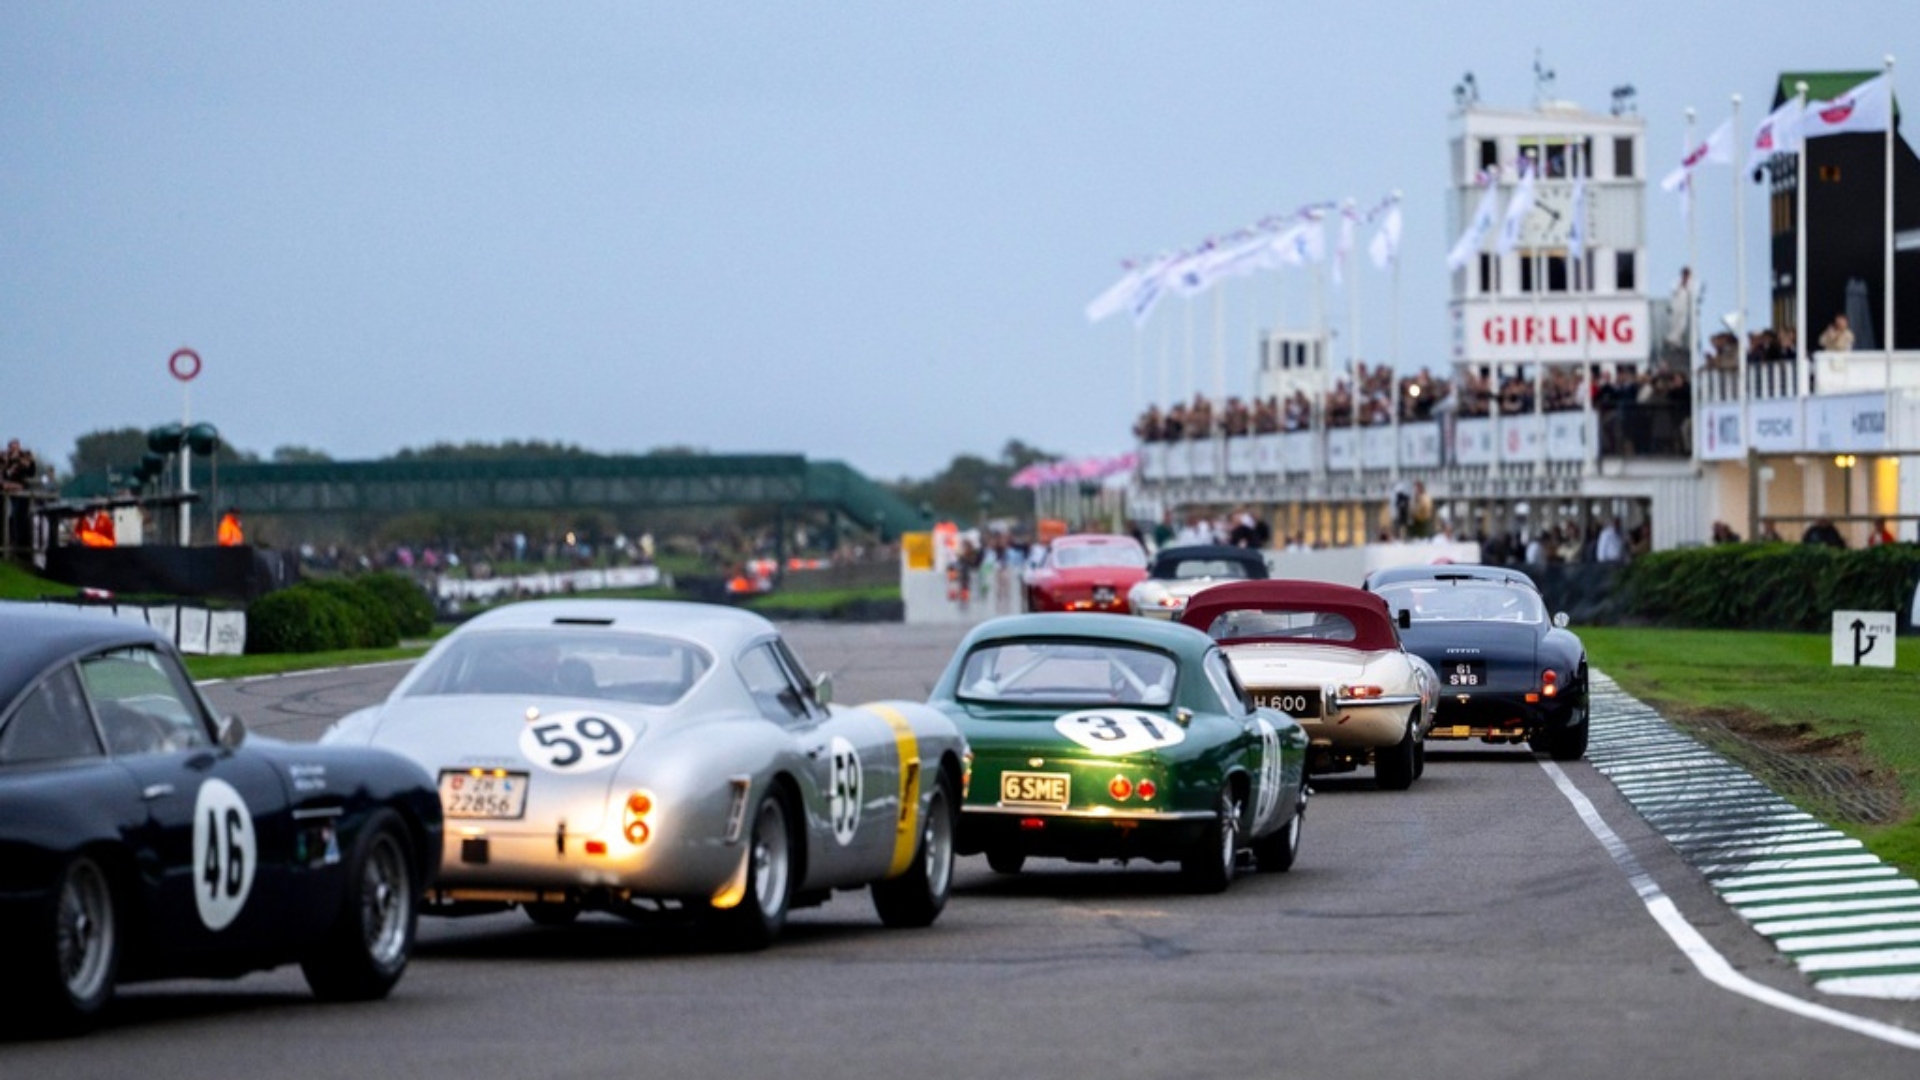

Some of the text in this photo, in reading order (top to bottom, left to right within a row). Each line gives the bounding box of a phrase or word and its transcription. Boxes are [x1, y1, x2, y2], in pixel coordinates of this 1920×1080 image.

[1483, 315, 1633, 345] GIRLING
[1869, 624, 1892, 634] PITS
[1450, 674, 1478, 685] SWB
[1270, 695, 1306, 711] 600
[1076, 715, 1165, 741] 31
[532, 717, 623, 767] 59
[472, 778, 494, 792] ZH
[835, 752, 858, 834] 59
[1006, 777, 1064, 800] 6 SME
[448, 794, 511, 815] 22856
[204, 807, 244, 900] 46
